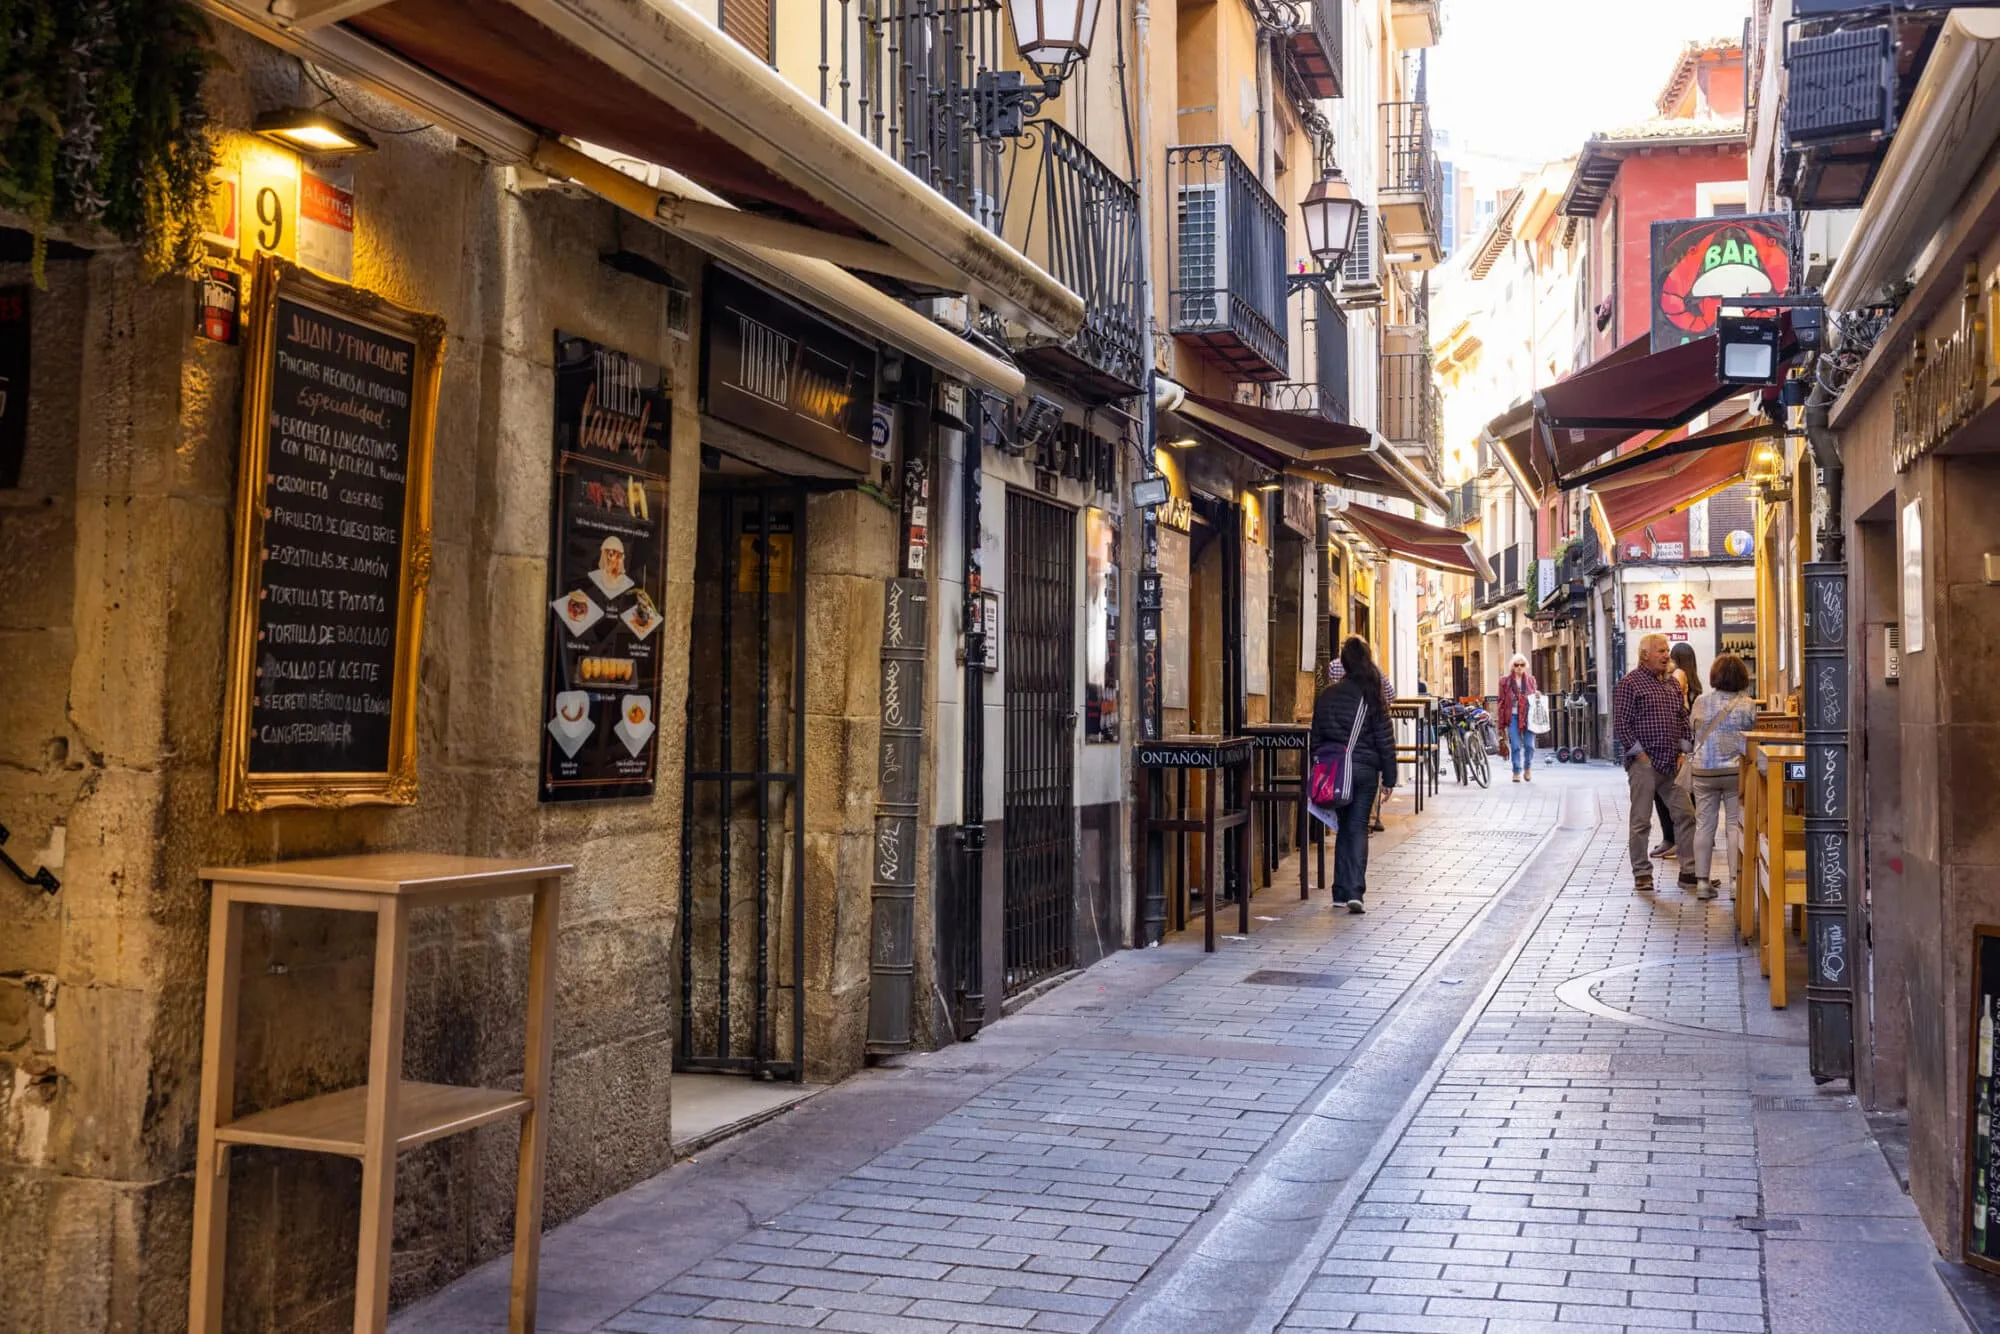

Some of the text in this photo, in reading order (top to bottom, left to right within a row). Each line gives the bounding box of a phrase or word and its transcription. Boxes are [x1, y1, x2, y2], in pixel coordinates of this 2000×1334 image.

[304, 185, 351, 216] Alarma
[256, 187, 282, 250] 9
[1704, 238, 1760, 271] BAR
[287, 312, 333, 352] JUAN
[346, 335, 409, 377] PINCHAME
[739, 316, 789, 405] TORRES
[278, 350, 320, 382] PINCHOS
[322, 366, 356, 394] HECHOS
[368, 381, 408, 409] MOMENTO
[594, 350, 641, 417] TORRES
[281, 416, 399, 462] BROCHETA LANGOSTINOS
[280, 438, 300, 457] CON
[329, 452, 377, 478] NATURAL
[276, 474, 384, 511] CROQUETA CASERAS
[274, 506, 397, 545] PIRULETA DE QUESO BRIE
[270, 544, 389, 579] ZAPATILLAS DE JAMÓN
[268, 584, 385, 613] TORTILLA DE PATATA
[1634, 593, 1696, 611] BAR
[267, 622, 391, 648] TORTILLA DE BACALAO
[1628, 614, 1662, 629] Villa
[1675, 613, 1707, 629] Rica
[318, 659, 336, 680] EN
[338, 661, 381, 683] ACEITE
[264, 692, 307, 711] SECRETO
[260, 721, 354, 745] CANGREBURGER
[1141, 750, 1212, 766] ONTAÑÓN
